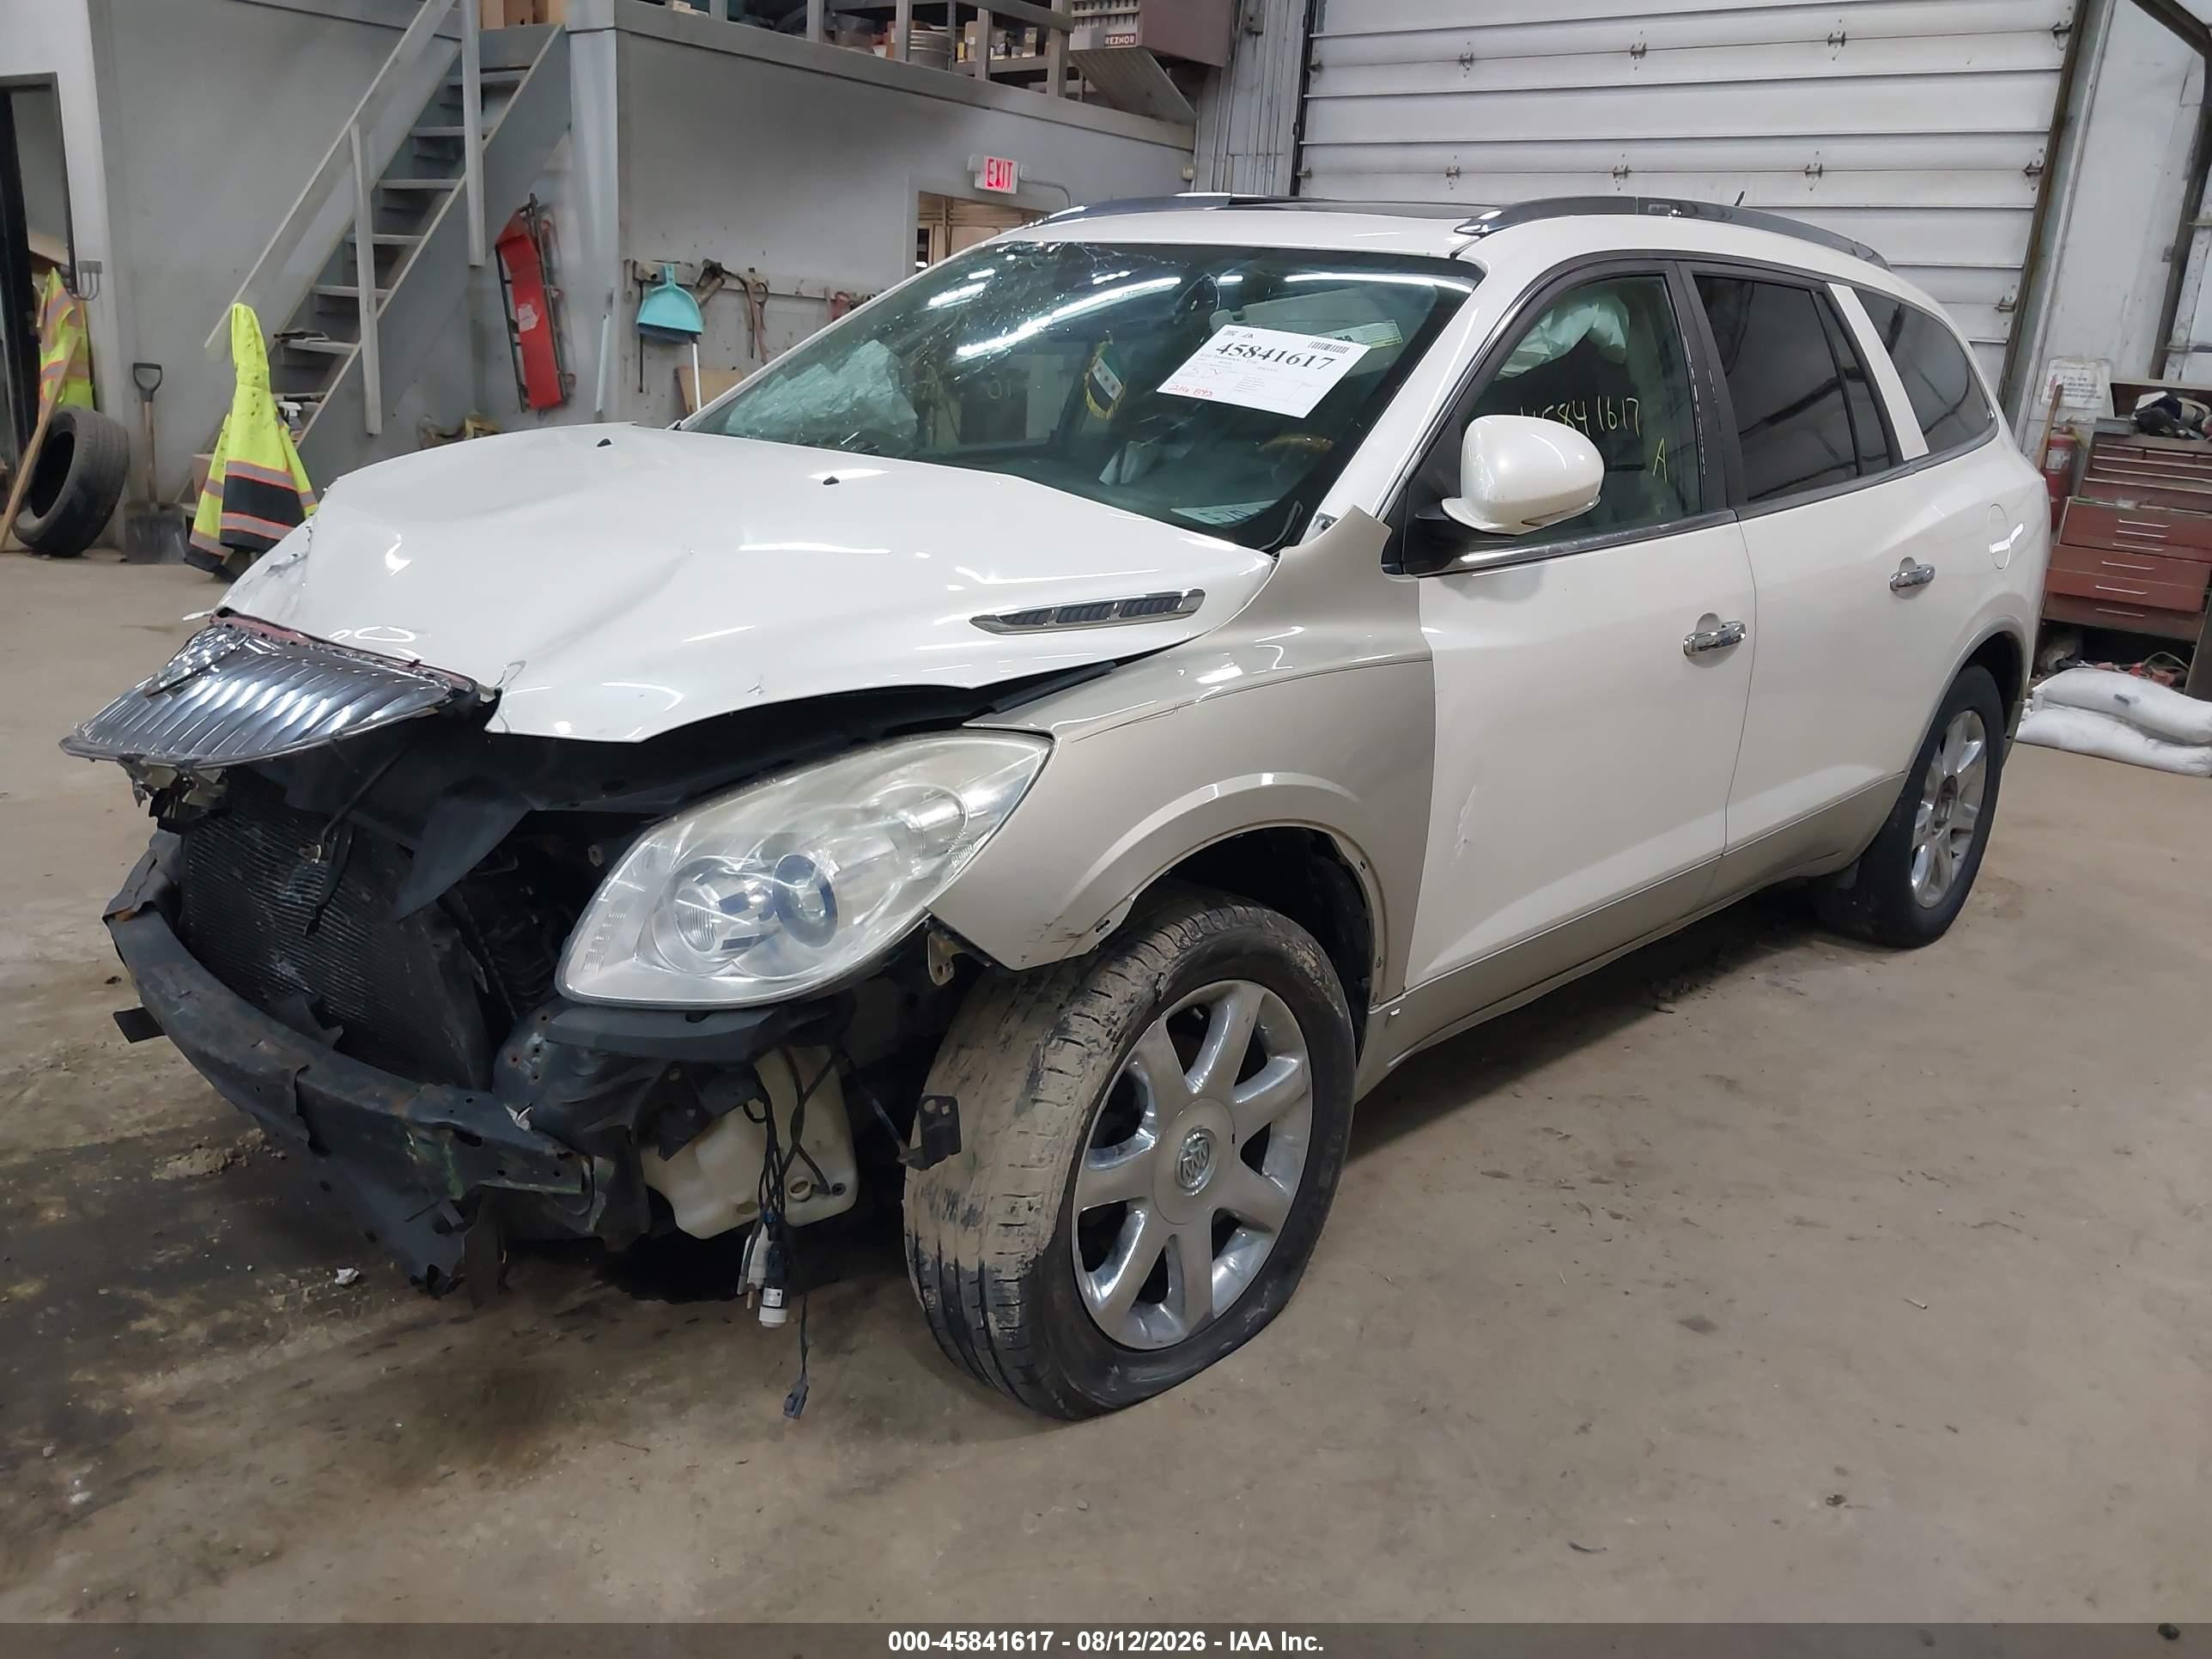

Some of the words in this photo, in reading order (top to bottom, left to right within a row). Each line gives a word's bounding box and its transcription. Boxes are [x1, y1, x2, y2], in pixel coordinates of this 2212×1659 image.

[987, 158, 1013, 189] EXIT
[1215, 342, 1339, 370] 45841617
[1521, 395, 1640, 438] 841617
[1652, 437, 1668, 483] A
